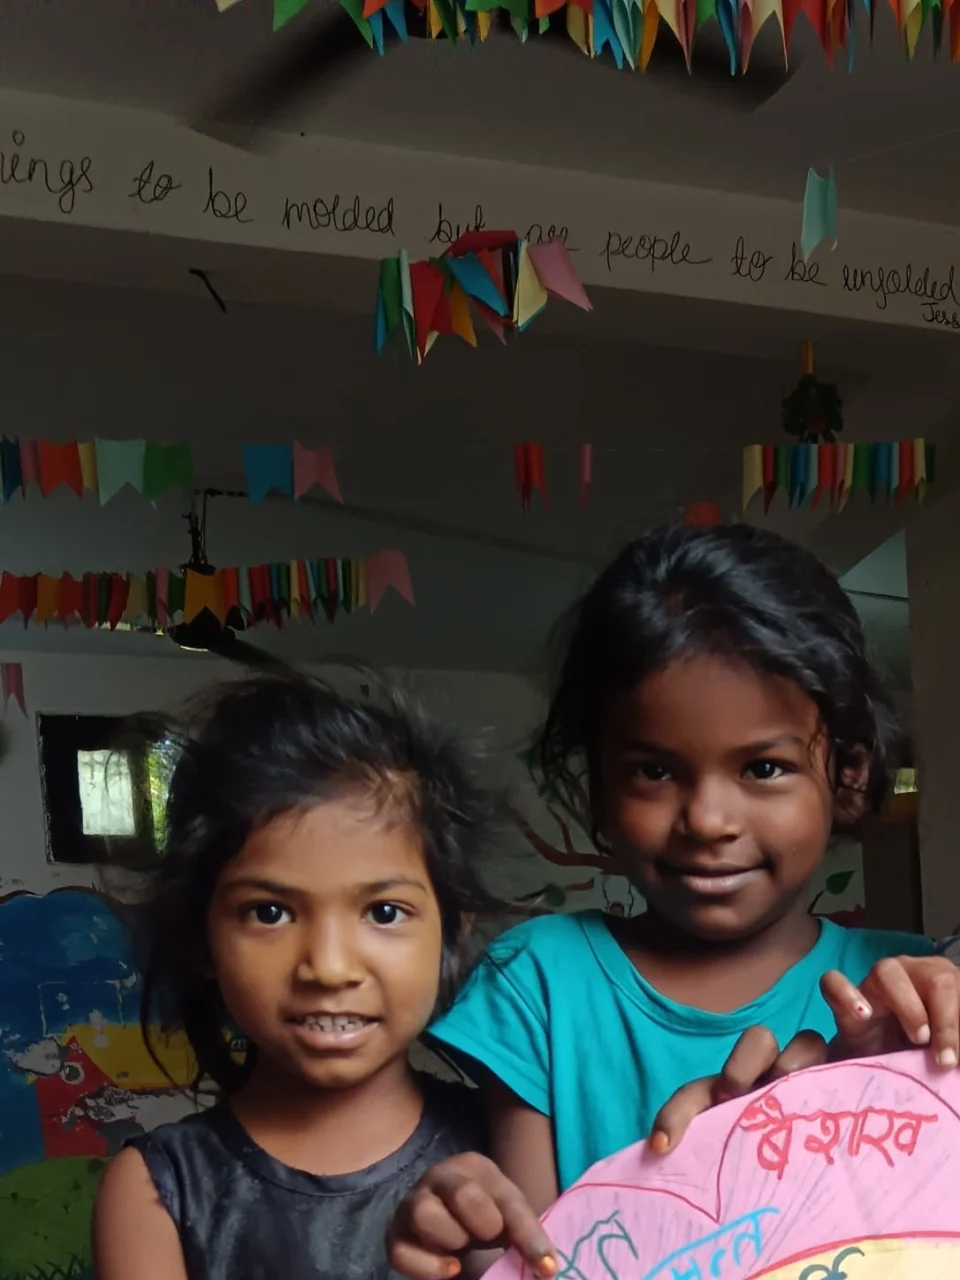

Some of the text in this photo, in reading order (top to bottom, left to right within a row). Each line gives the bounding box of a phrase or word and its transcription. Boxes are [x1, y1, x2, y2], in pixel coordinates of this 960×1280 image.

[128, 160, 184, 203] to
[203, 167, 254, 223] be
[281, 195, 396, 237] molded
[599, 229, 714, 274] people
[730, 236, 774, 282] to
[784, 241, 826, 286] be
[842, 264, 960, 310] unfolded
